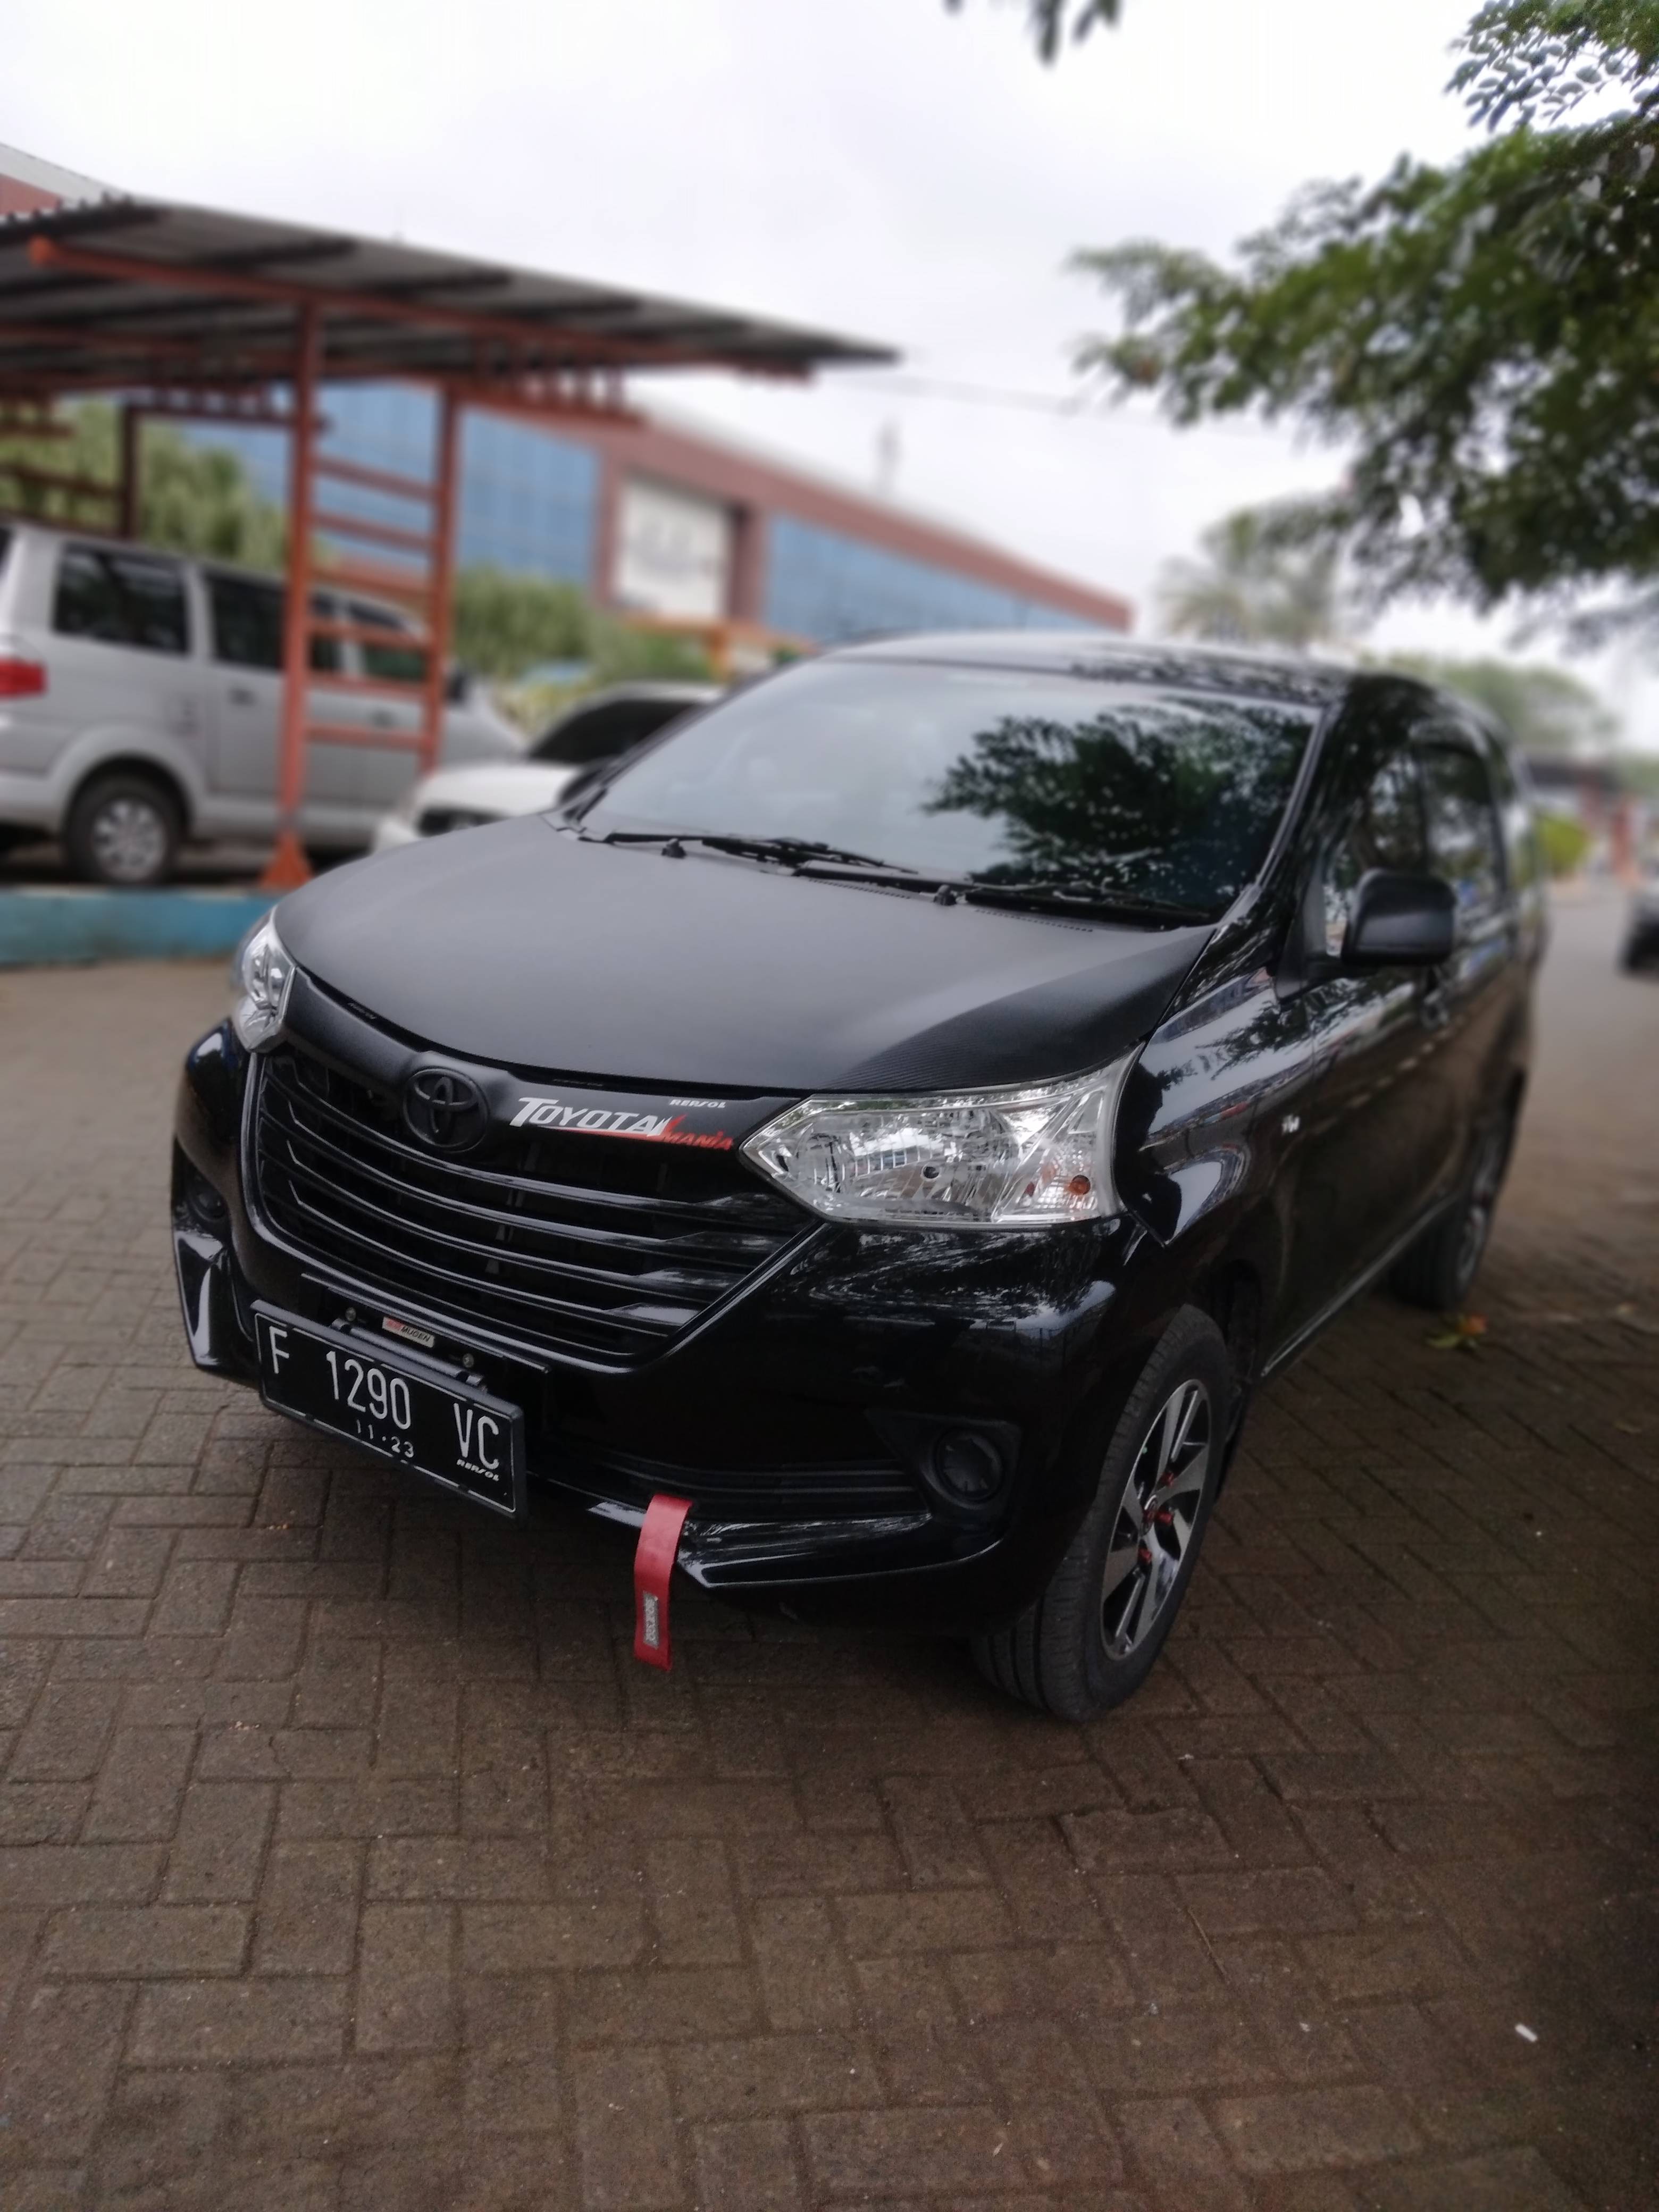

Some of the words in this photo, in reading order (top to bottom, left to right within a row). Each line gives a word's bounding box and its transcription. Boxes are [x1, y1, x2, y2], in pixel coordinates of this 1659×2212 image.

[509, 1096, 659, 1136] TOYOTA
[669, 1099, 726, 1109] REPSOL
[269, 1326, 290, 1374] F
[325, 1350, 411, 1430] 1290
[453, 1402, 499, 1470] VC
